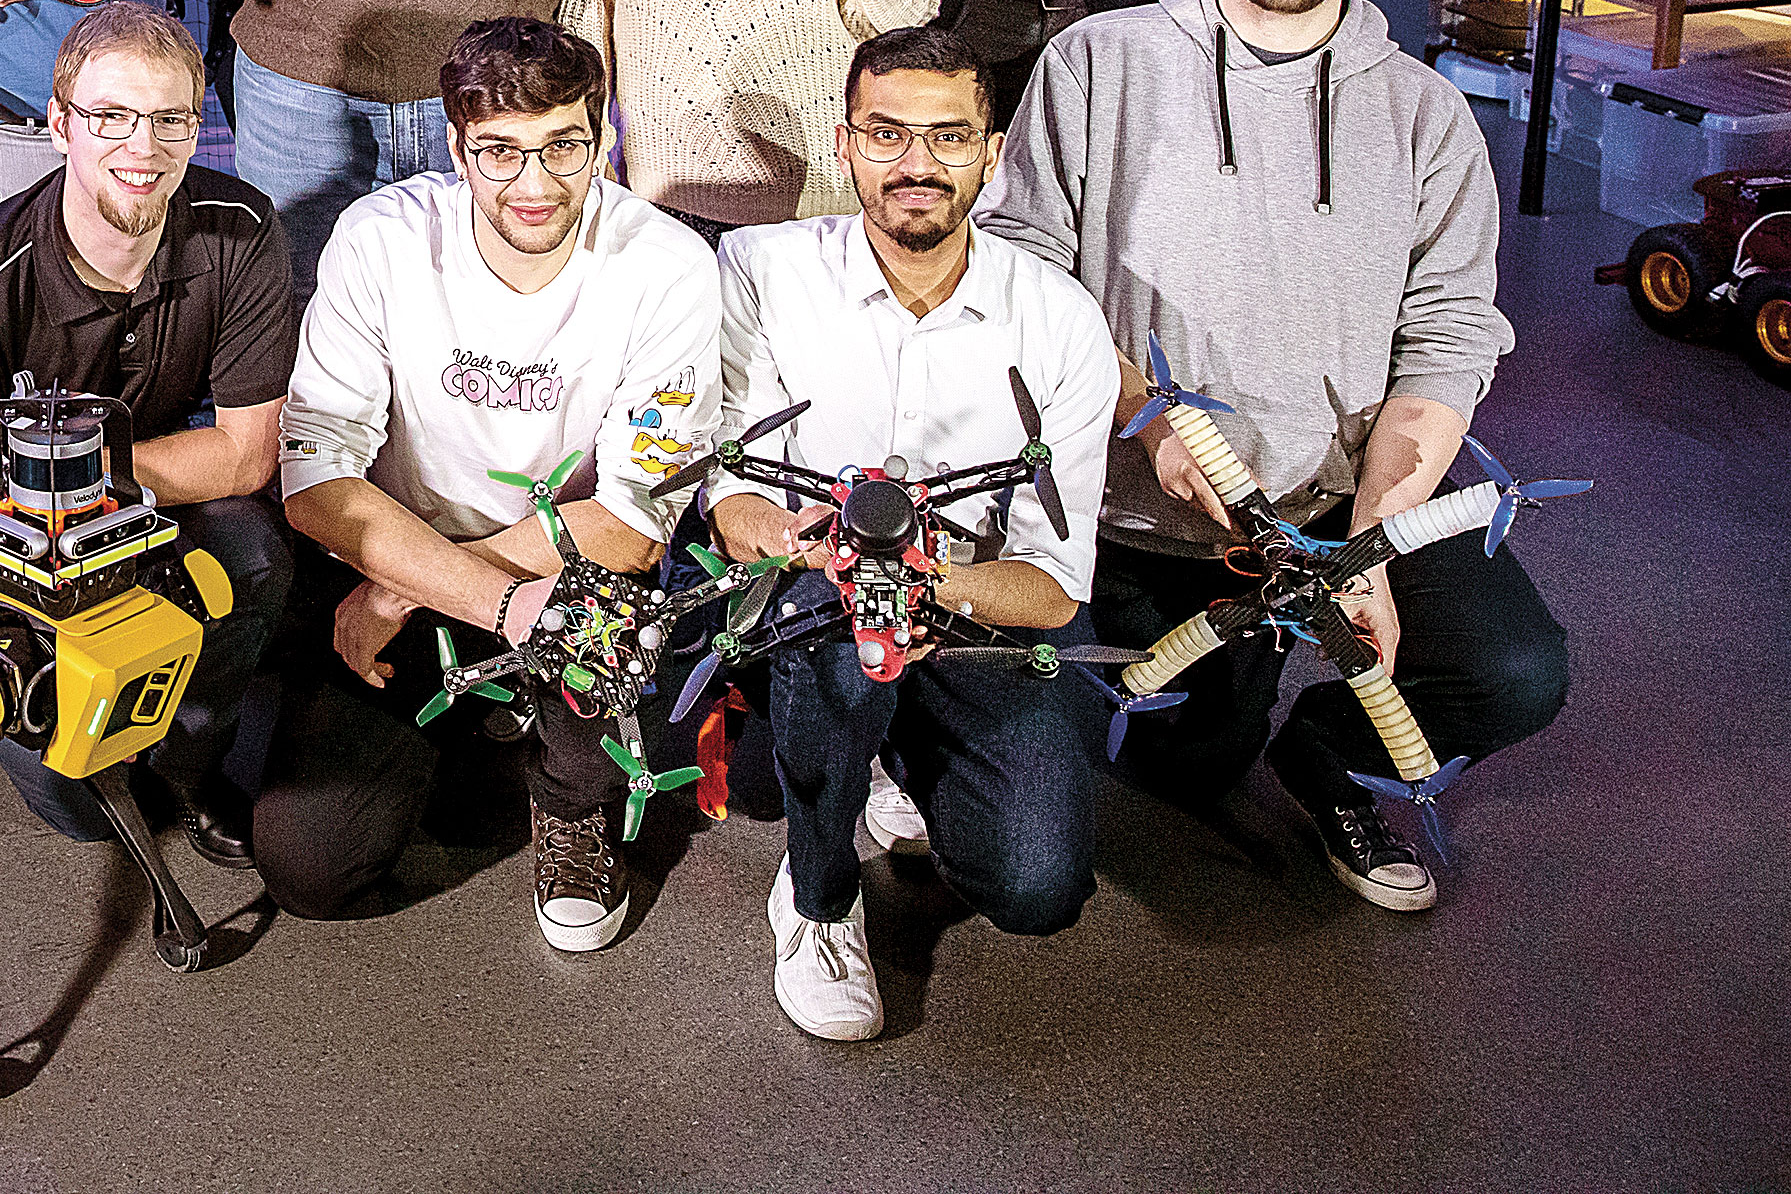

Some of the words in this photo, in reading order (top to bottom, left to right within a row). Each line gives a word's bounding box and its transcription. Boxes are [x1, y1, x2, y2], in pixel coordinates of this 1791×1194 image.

[452, 348, 493, 371] Walt
[496, 357, 559, 378] Disney's
[441, 363, 564, 412] COMICS
